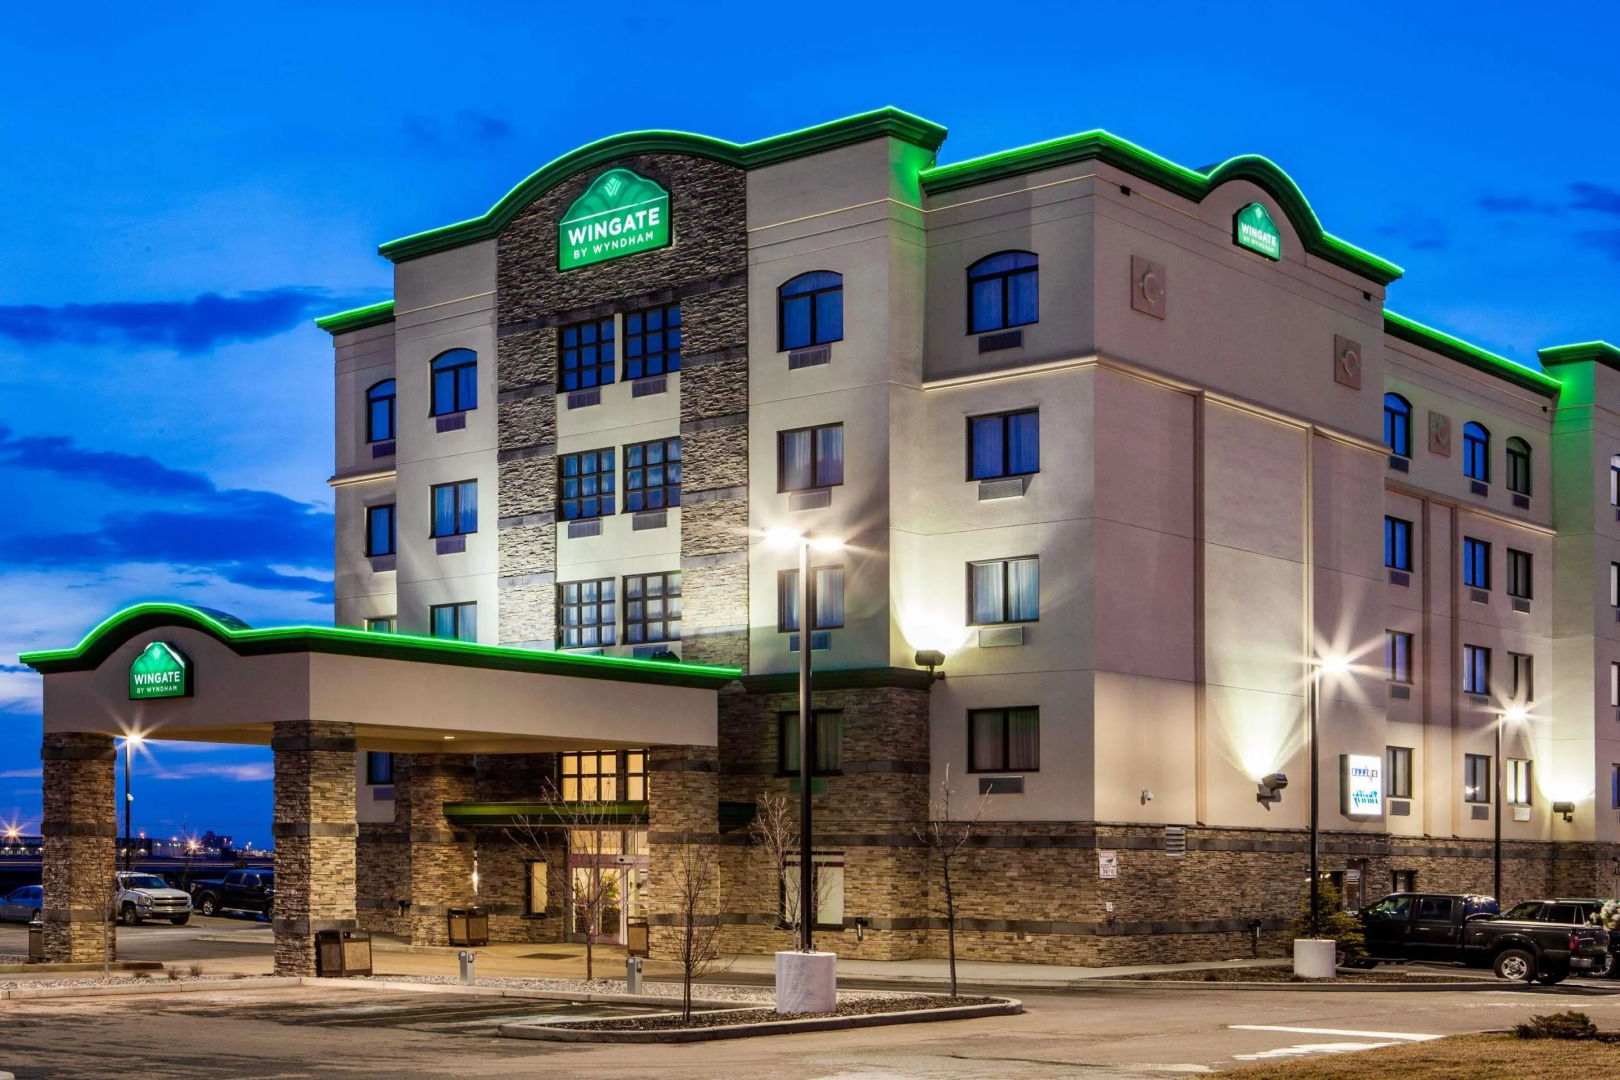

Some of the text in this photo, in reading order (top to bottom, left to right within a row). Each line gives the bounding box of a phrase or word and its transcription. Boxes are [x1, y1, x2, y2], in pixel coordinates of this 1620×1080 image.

[568, 207, 660, 246] WINGATE
[1241, 222, 1277, 247] WINGATE
[573, 231, 654, 260] BY WYNDHAM
[134, 671, 180, 685] WINGATE
